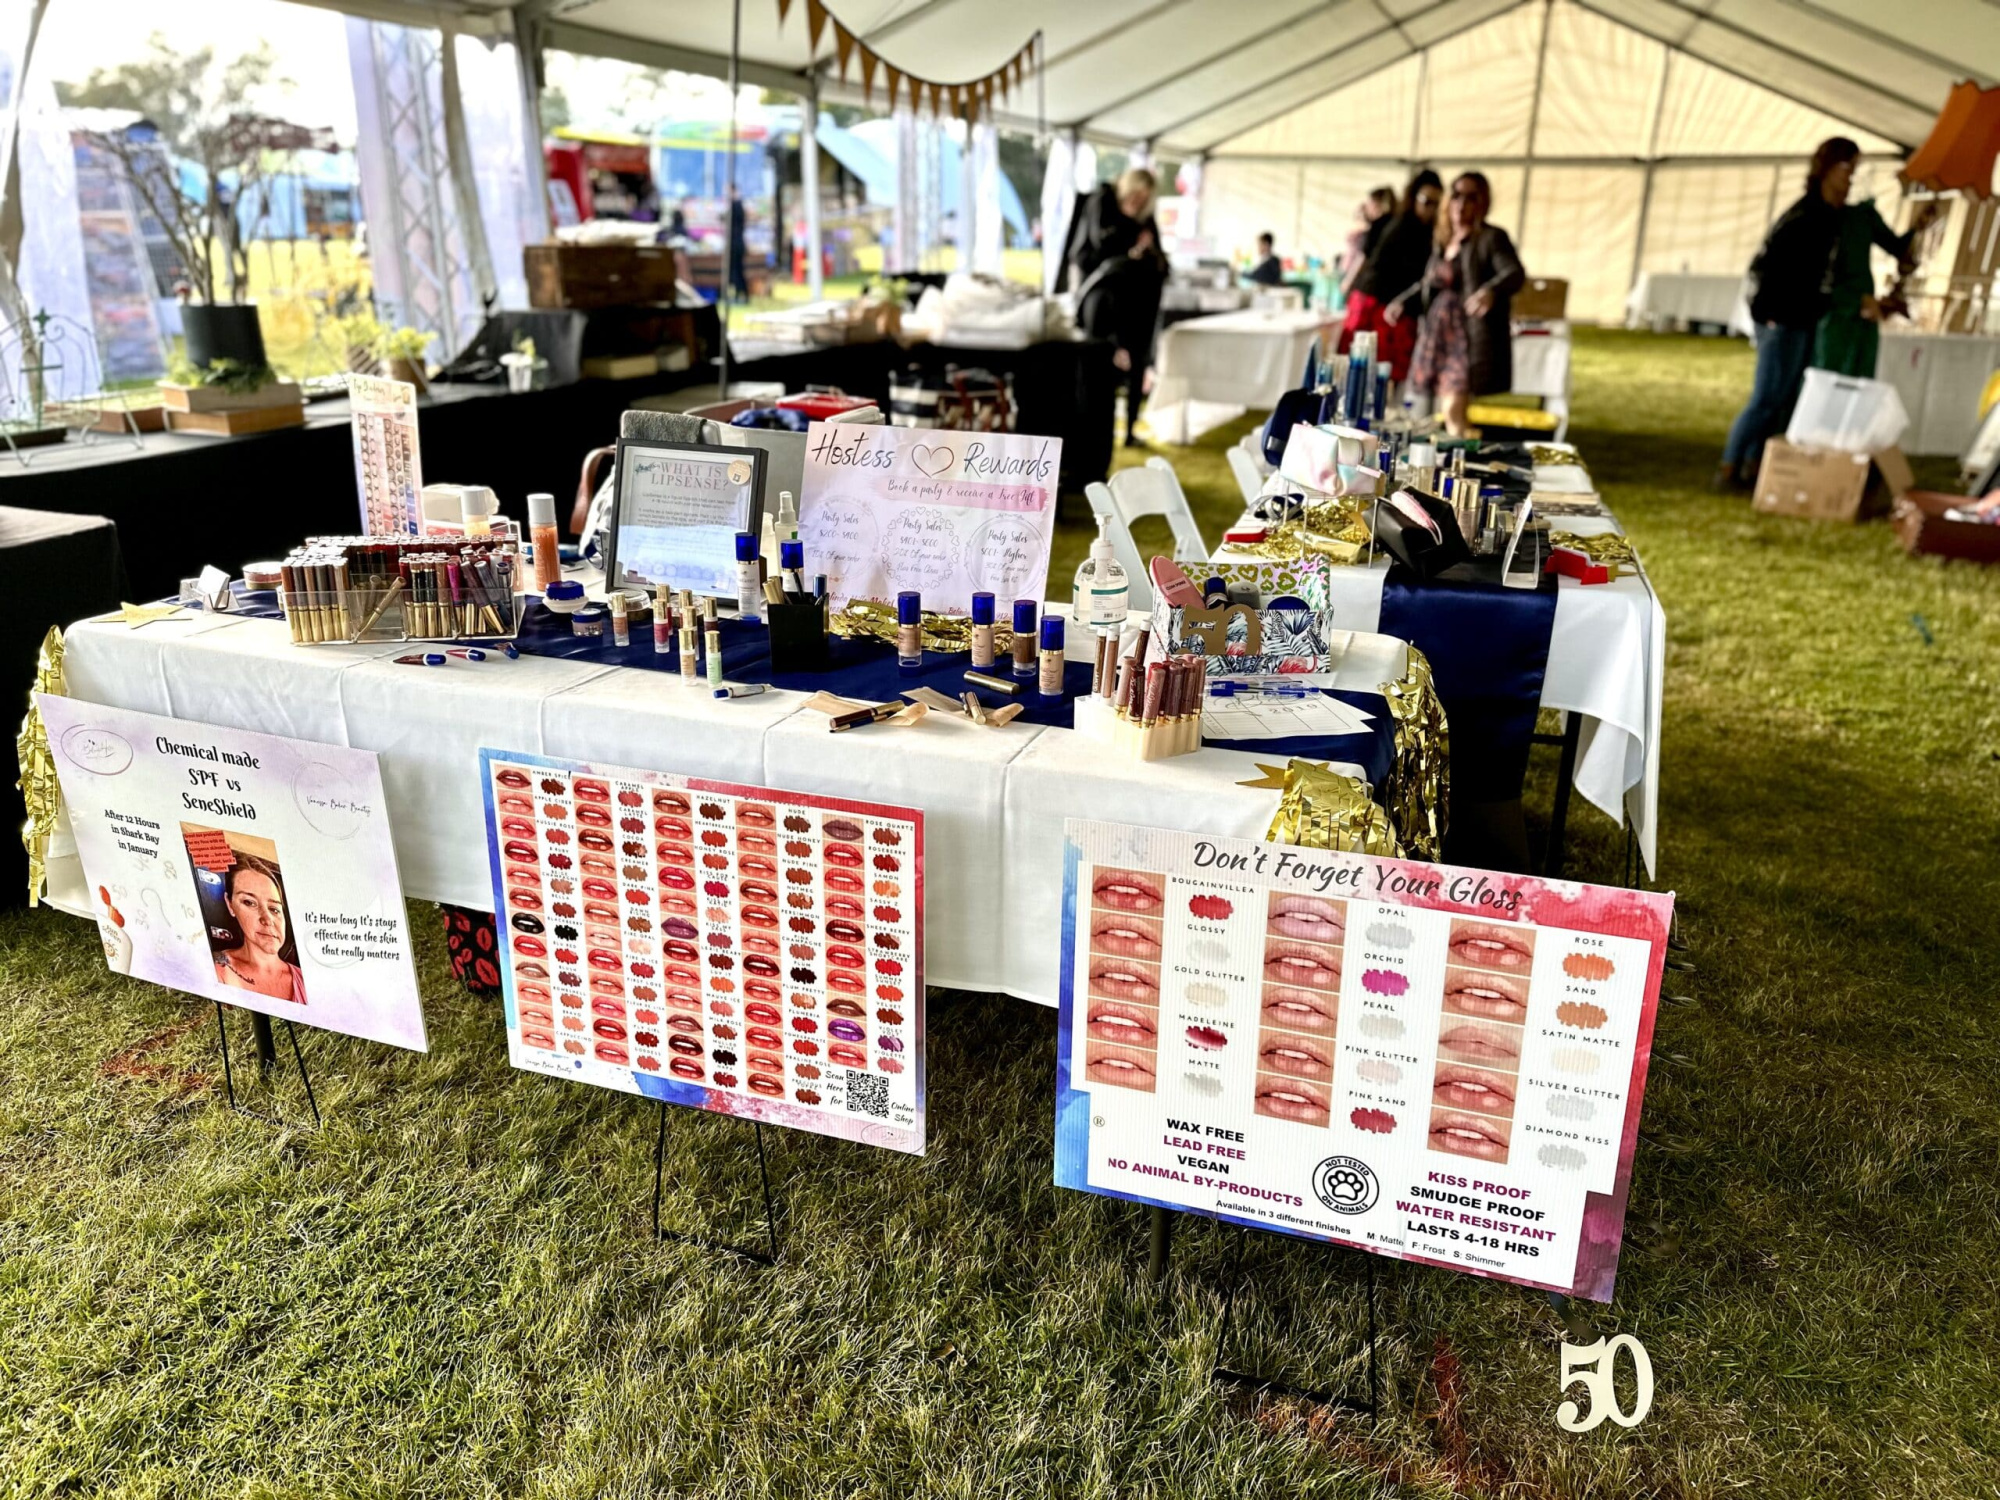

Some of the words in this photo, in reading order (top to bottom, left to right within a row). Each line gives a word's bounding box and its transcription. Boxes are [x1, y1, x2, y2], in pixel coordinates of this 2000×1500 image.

[812, 429, 897, 469] Hostess
[964, 440, 1052, 481] Rewards
[661, 462, 702, 476] WHAT
[708, 466, 722, 477] IS
[652, 474, 728, 491] LIPSENSE?
[888, 479, 910, 493] Book
[920, 483, 942, 500] party
[956, 488, 984, 498] receive
[156, 736, 218, 762] Chemical
[222, 745, 260, 770] made
[189, 768, 219, 788] SPF
[227, 779, 241, 792] vs
[615, 781, 644, 789] CARAMEL
[182, 792, 256, 820] SeneShield
[696, 795, 730, 804] HAZELNUT
[104, 809, 124, 824] After
[126, 814, 133, 824] 12
[135, 816, 160, 830] Hours
[886, 823, 913, 831] QUARTZ
[111, 824, 120, 834] in
[122, 825, 144, 840] Shark
[145, 831, 160, 845] Bay
[118, 840, 126, 850] in
[128, 842, 158, 859] January
[869, 846, 906, 855] ROSEBERRY
[1172, 877, 1255, 893] BOUGAINVILLEA
[1194, 842, 1268, 874] Don't
[1275, 853, 1363, 891] Forget
[1375, 864, 1440, 900] Your
[1449, 876, 1524, 912] Gloss
[305, 912, 317, 924] It's
[320, 914, 337, 926] How
[339, 914, 358, 928] long
[360, 915, 373, 927] It's
[375, 918, 397, 930] stays
[781, 910, 820, 919] PERSIMMON
[1378, 908, 1406, 917] OPAL
[314, 929, 348, 943] effective
[351, 934, 362, 942] on
[364, 930, 378, 943] the
[380, 932, 398, 944] skin
[1187, 924, 1226, 935] GLOSSY
[782, 936, 821, 947] CHAMPAGNE
[1574, 937, 1604, 947] ROSE
[322, 945, 338, 956] that
[341, 945, 365, 962] really
[367, 949, 400, 961] matters
[1364, 953, 1404, 964] ORCHID
[1174, 965, 1200, 975] GOLD
[1205, 970, 1246, 982] GLITTER
[1566, 986, 1597, 996] SAND
[1363, 1001, 1395, 1012] PEARL
[1178, 1014, 1235, 1029] MADELEINE
[1542, 1030, 1576, 1040] SATIN
[1583, 1036, 1620, 1048] MATTE
[1346, 1045, 1369, 1055] PINK
[1375, 1050, 1418, 1064] GLITTER
[1188, 1059, 1220, 1069] MATTE
[825, 1071, 844, 1081] Scan
[827, 1083, 843, 1092] Here
[1528, 1079, 1569, 1091] SILVER
[1574, 1086, 1620, 1100] GLITTER
[830, 1096, 843, 1105] for
[1349, 1090, 1372, 1100] PINK
[1378, 1096, 1406, 1106] SAND
[891, 1102, 914, 1113] Online
[895, 1114, 914, 1124] Shop
[1166, 1118, 1200, 1134] WAX
[1206, 1126, 1244, 1142] FREE
[1525, 1124, 1578, 1140] DIAMOND
[1584, 1134, 1610, 1145] KISS
[1163, 1134, 1202, 1151] LEAD
[1207, 1144, 1246, 1160] FREE
[1177, 1154, 1229, 1174] VEGAN
[1325, 1159, 1340, 1168] NOT
[1344, 1159, 1369, 1176] TESTED
[1108, 1158, 1128, 1170] NO
[1132, 1163, 1189, 1182] ANIMAL
[1194, 1175, 1303, 1206] BY-PRODUCTS
[1428, 1171, 1468, 1188] KISS
[1473, 1180, 1531, 1200] PROOF
[1322, 1196, 1333, 1206] ON
[1334, 1203, 1368, 1212] ANIMALS
[1410, 1186, 1482, 1210] SMUDGE
[1487, 1201, 1545, 1222] PROOF
[1216, 1200, 1256, 1216] Available
[1258, 1208, 1266, 1217] in
[1276, 1213, 1314, 1229] different
[1315, 1220, 1350, 1236] finishes
[1396, 1200, 1454, 1222] WATER
[1460, 1214, 1556, 1242] RESISTANT
[1407, 1221, 1460, 1241] LASTS
[1464, 1233, 1500, 1248] 4-18
[1504, 1241, 1540, 1257] HRS
[1366, 1232, 1377, 1240] M:
[1380, 1234, 1404, 1246] Matte
[1412, 1242, 1420, 1250] F:
[1422, 1244, 1446, 1256] Frost
[1454, 1250, 1462, 1260] S:
[1465, 1252, 1506, 1269] Shimmer
[1557, 1334, 1654, 1432] 50
